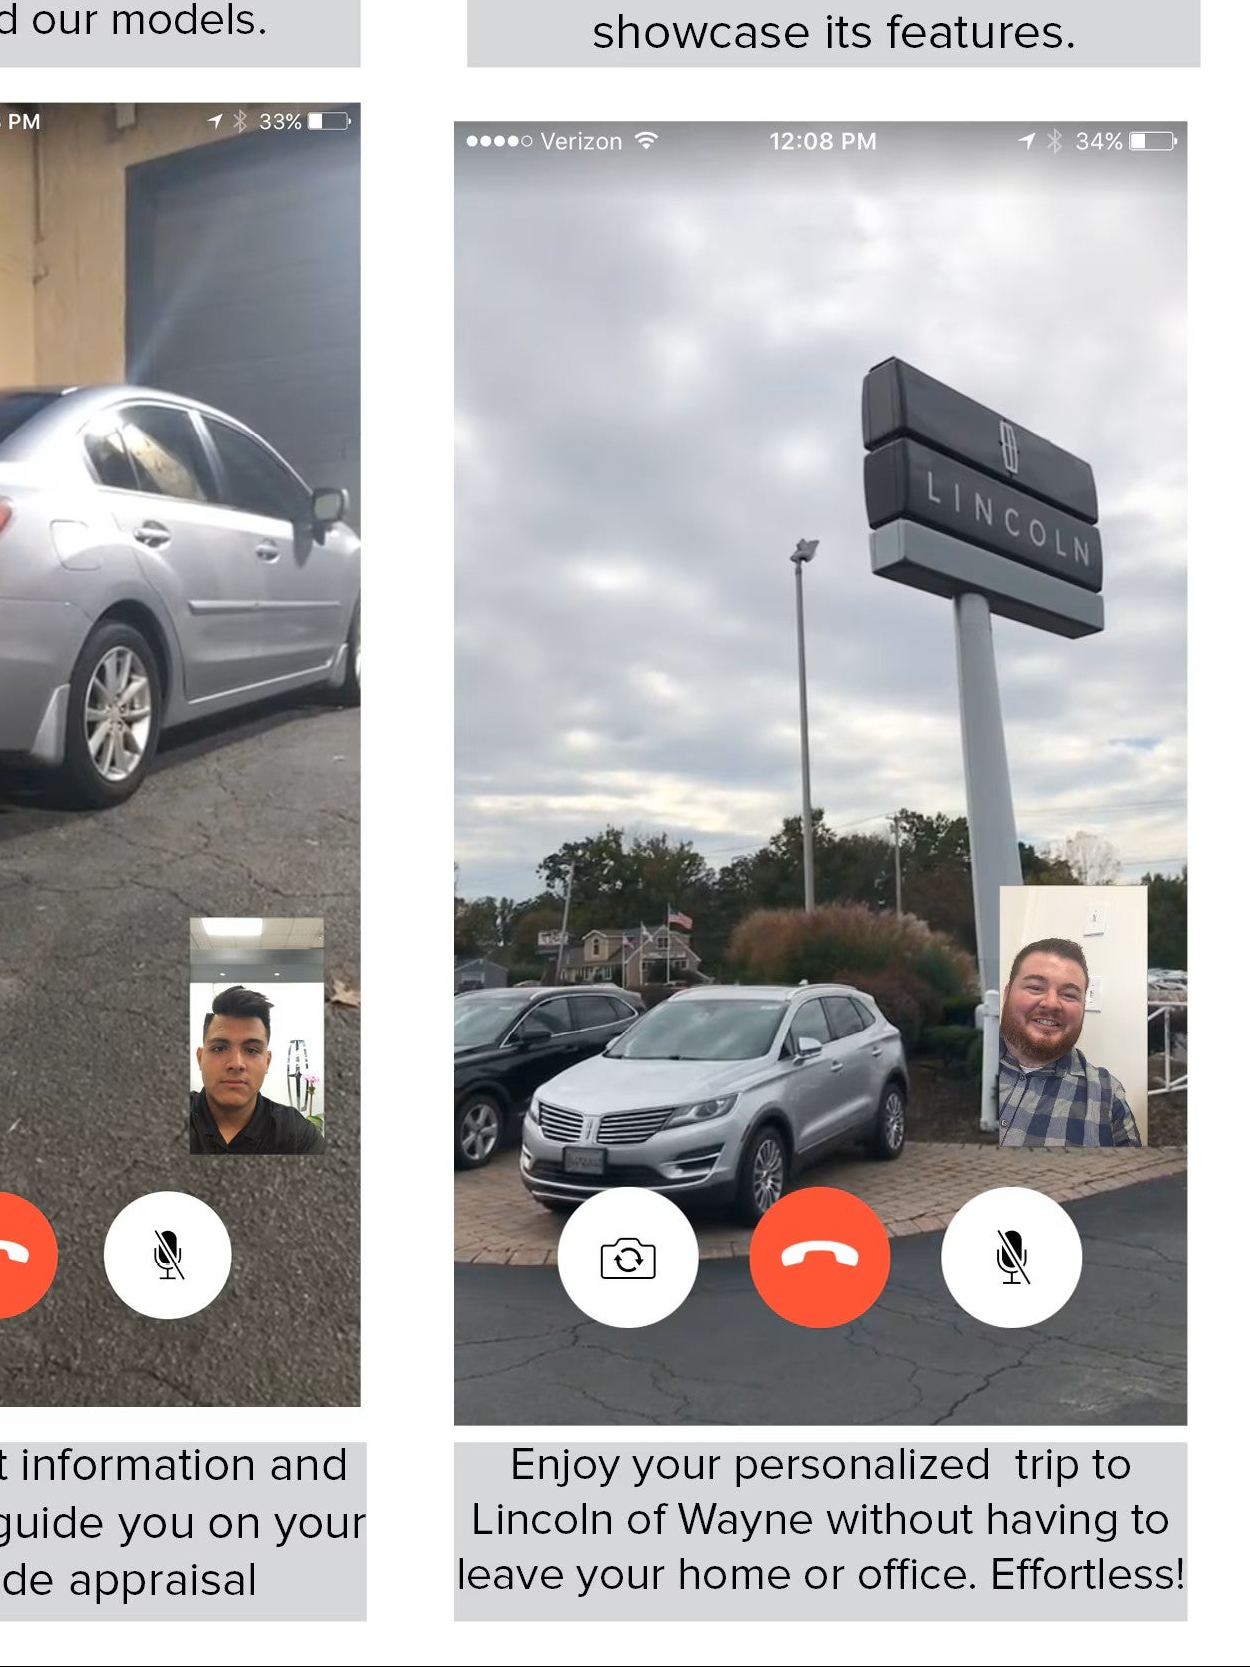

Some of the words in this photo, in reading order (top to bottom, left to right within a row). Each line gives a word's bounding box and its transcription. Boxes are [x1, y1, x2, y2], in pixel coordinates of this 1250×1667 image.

[8, 113, 40, 130] PM
[260, 113, 302, 130] 33%
[540, 131, 622, 150] Verizon
[769, 132, 834, 151] 12:08
[841, 132, 877, 151] PM
[1076, 132, 1123, 151] 34%
[926, 470, 1090, 567] LINCOLN
